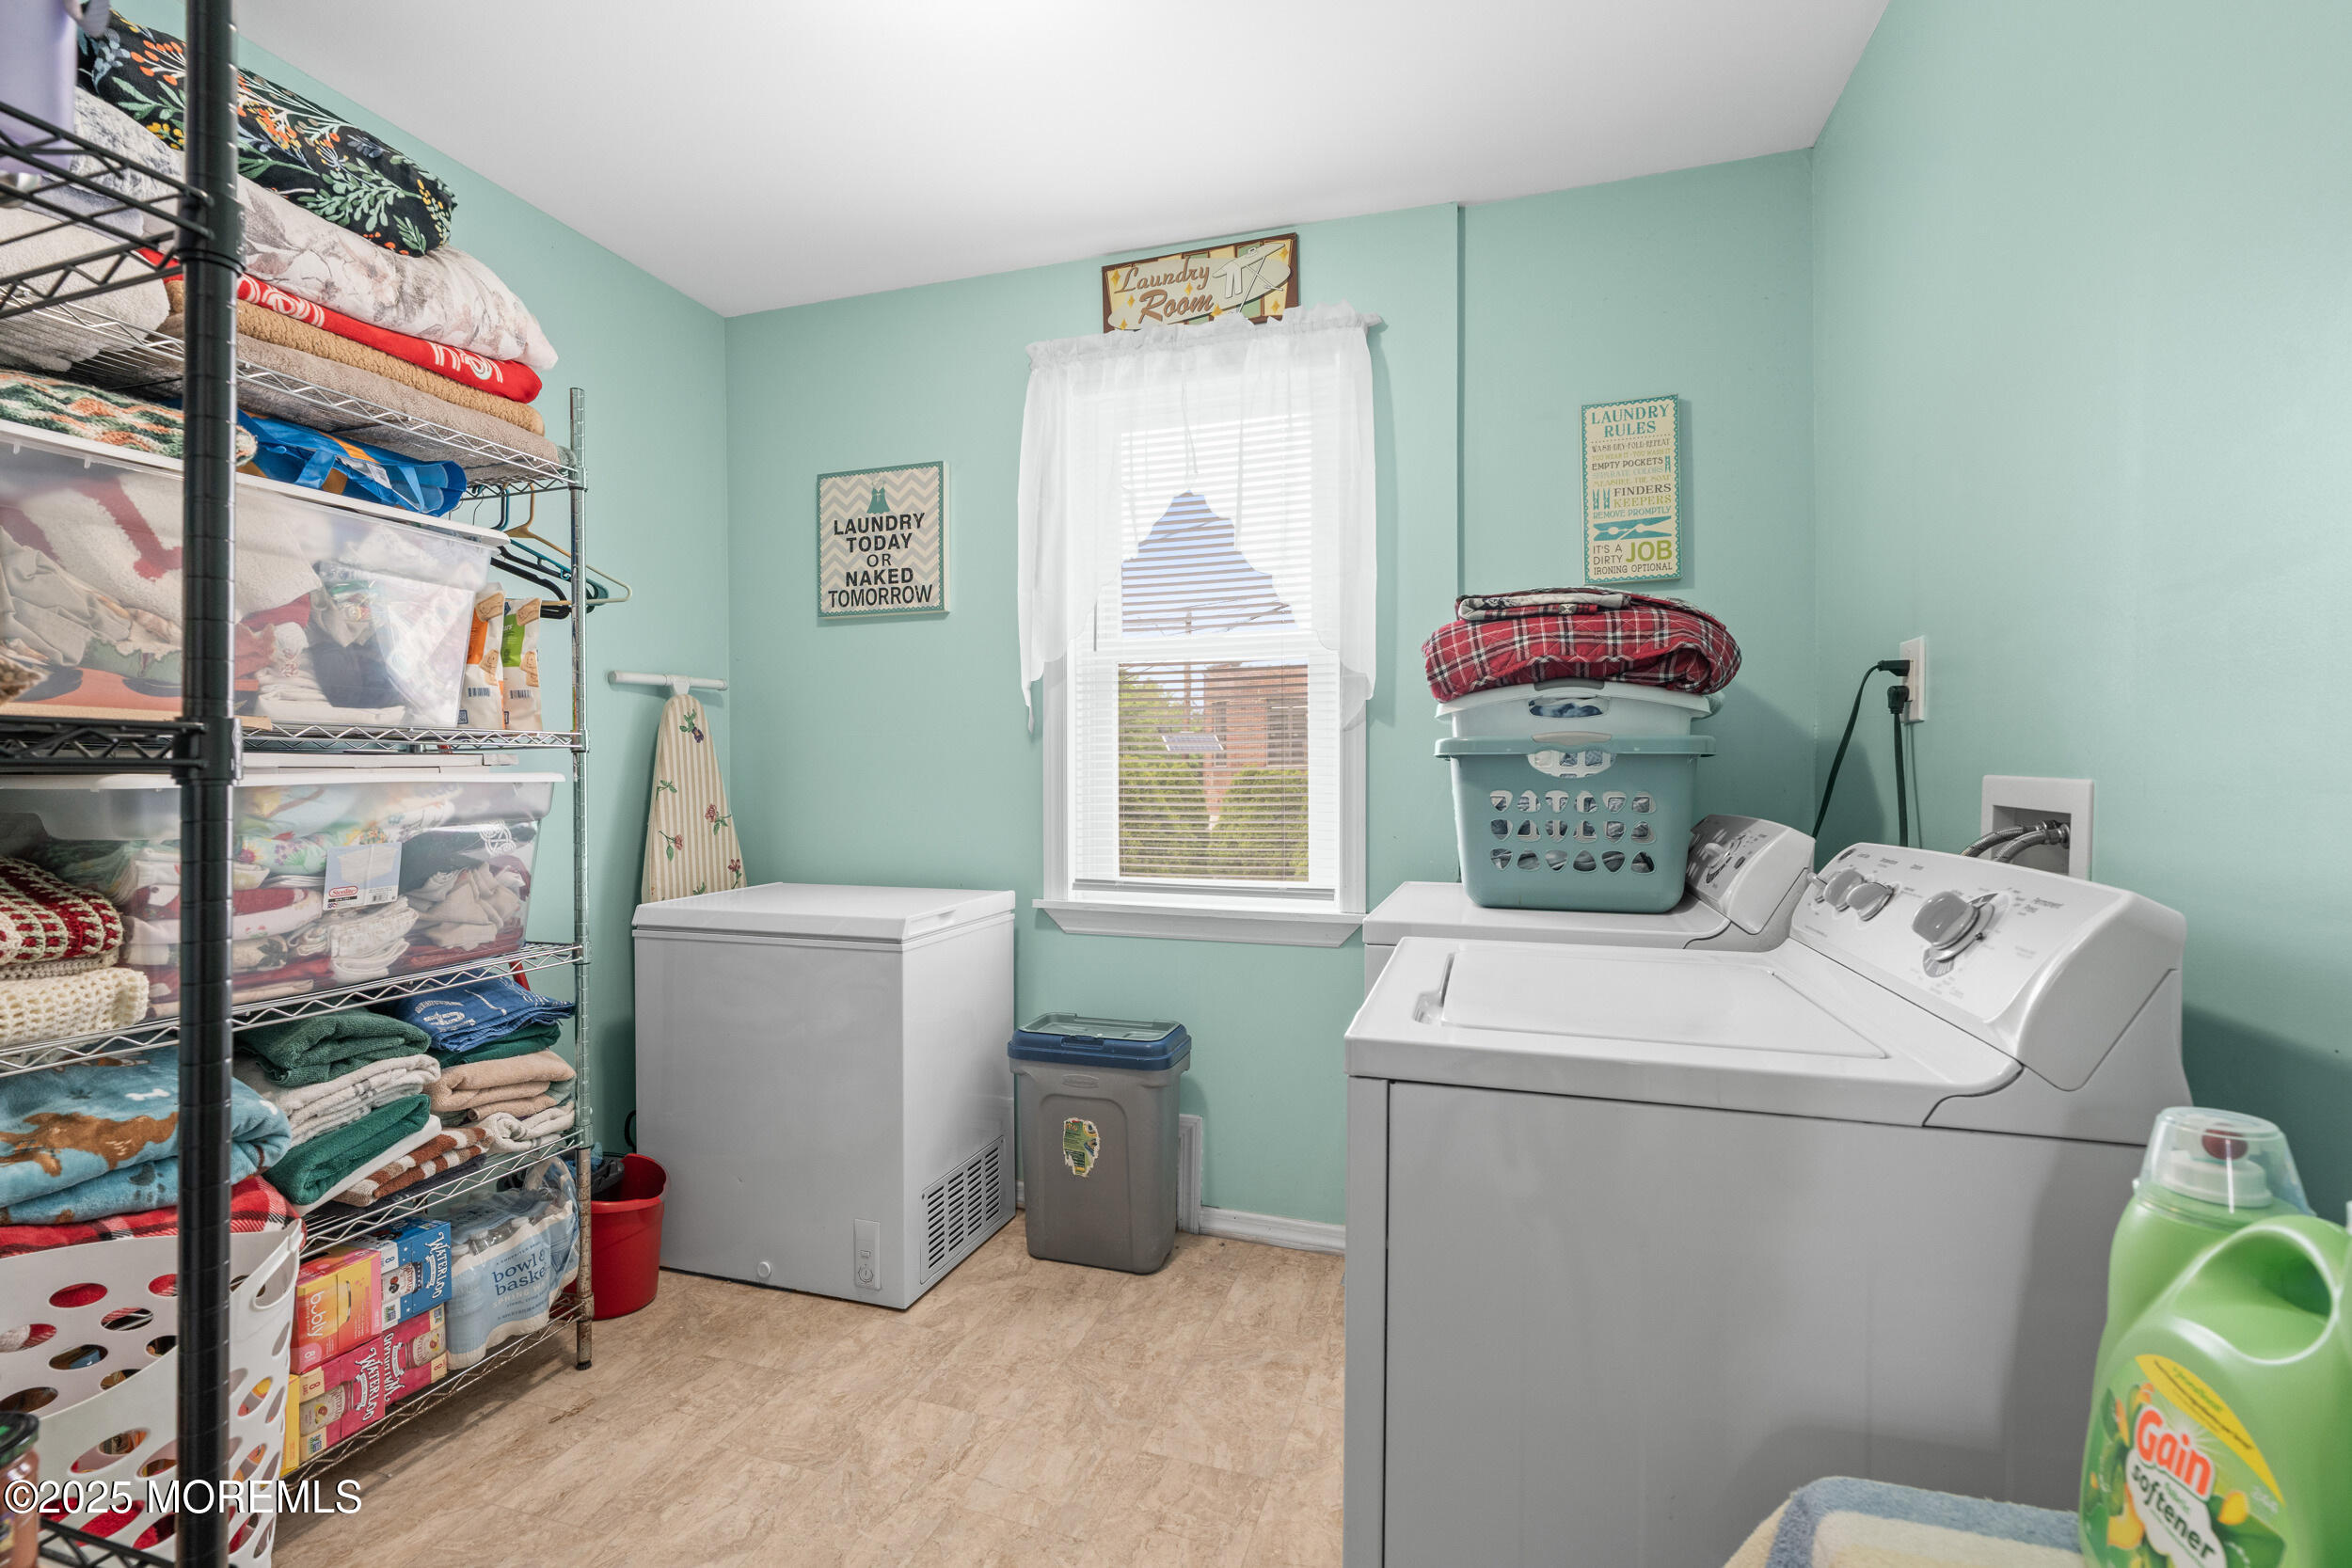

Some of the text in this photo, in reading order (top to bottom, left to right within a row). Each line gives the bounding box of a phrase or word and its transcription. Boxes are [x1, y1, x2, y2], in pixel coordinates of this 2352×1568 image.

[1114, 257, 1210, 294] Laundry
[1138, 289, 1214, 324] Room
[1591, 404, 1669, 424] LAUNDRY
[1604, 421, 1656, 438] RULES
[1592, 457, 1663, 471] EMPTY POCKETS
[1614, 483, 1671, 497] FINDERS
[1613, 494, 1671, 508] KEEPERS
[1593, 506, 1671, 520] REMOVE PROMPTLY
[834, 513, 925, 536] LAUNDRY
[846, 533, 912, 553] TODAY
[1593, 544, 1622, 554] IT'S A
[1625, 539, 1673, 563] JOB
[867, 553, 892, 567] OR
[1593, 554, 1623, 565] DIRTY
[1594, 562, 1673, 575] IRONING OPTIONAL
[846, 568, 914, 586] NAKED
[828, 584, 932, 608] TOMORROW
[385, 1256, 395, 1264] 8
[425, 1231, 451, 1299] WATERLOO
[492, 1253, 537, 1283] bowl
[307, 1291, 327, 1337] bubly
[304, 1350, 316, 1359] 8
[309, 1381, 321, 1390] 8
[355, 1347, 383, 1421] WATERLOO
[2137, 1409, 2212, 1497] Gain
[2130, 1465, 2216, 1558] softener
